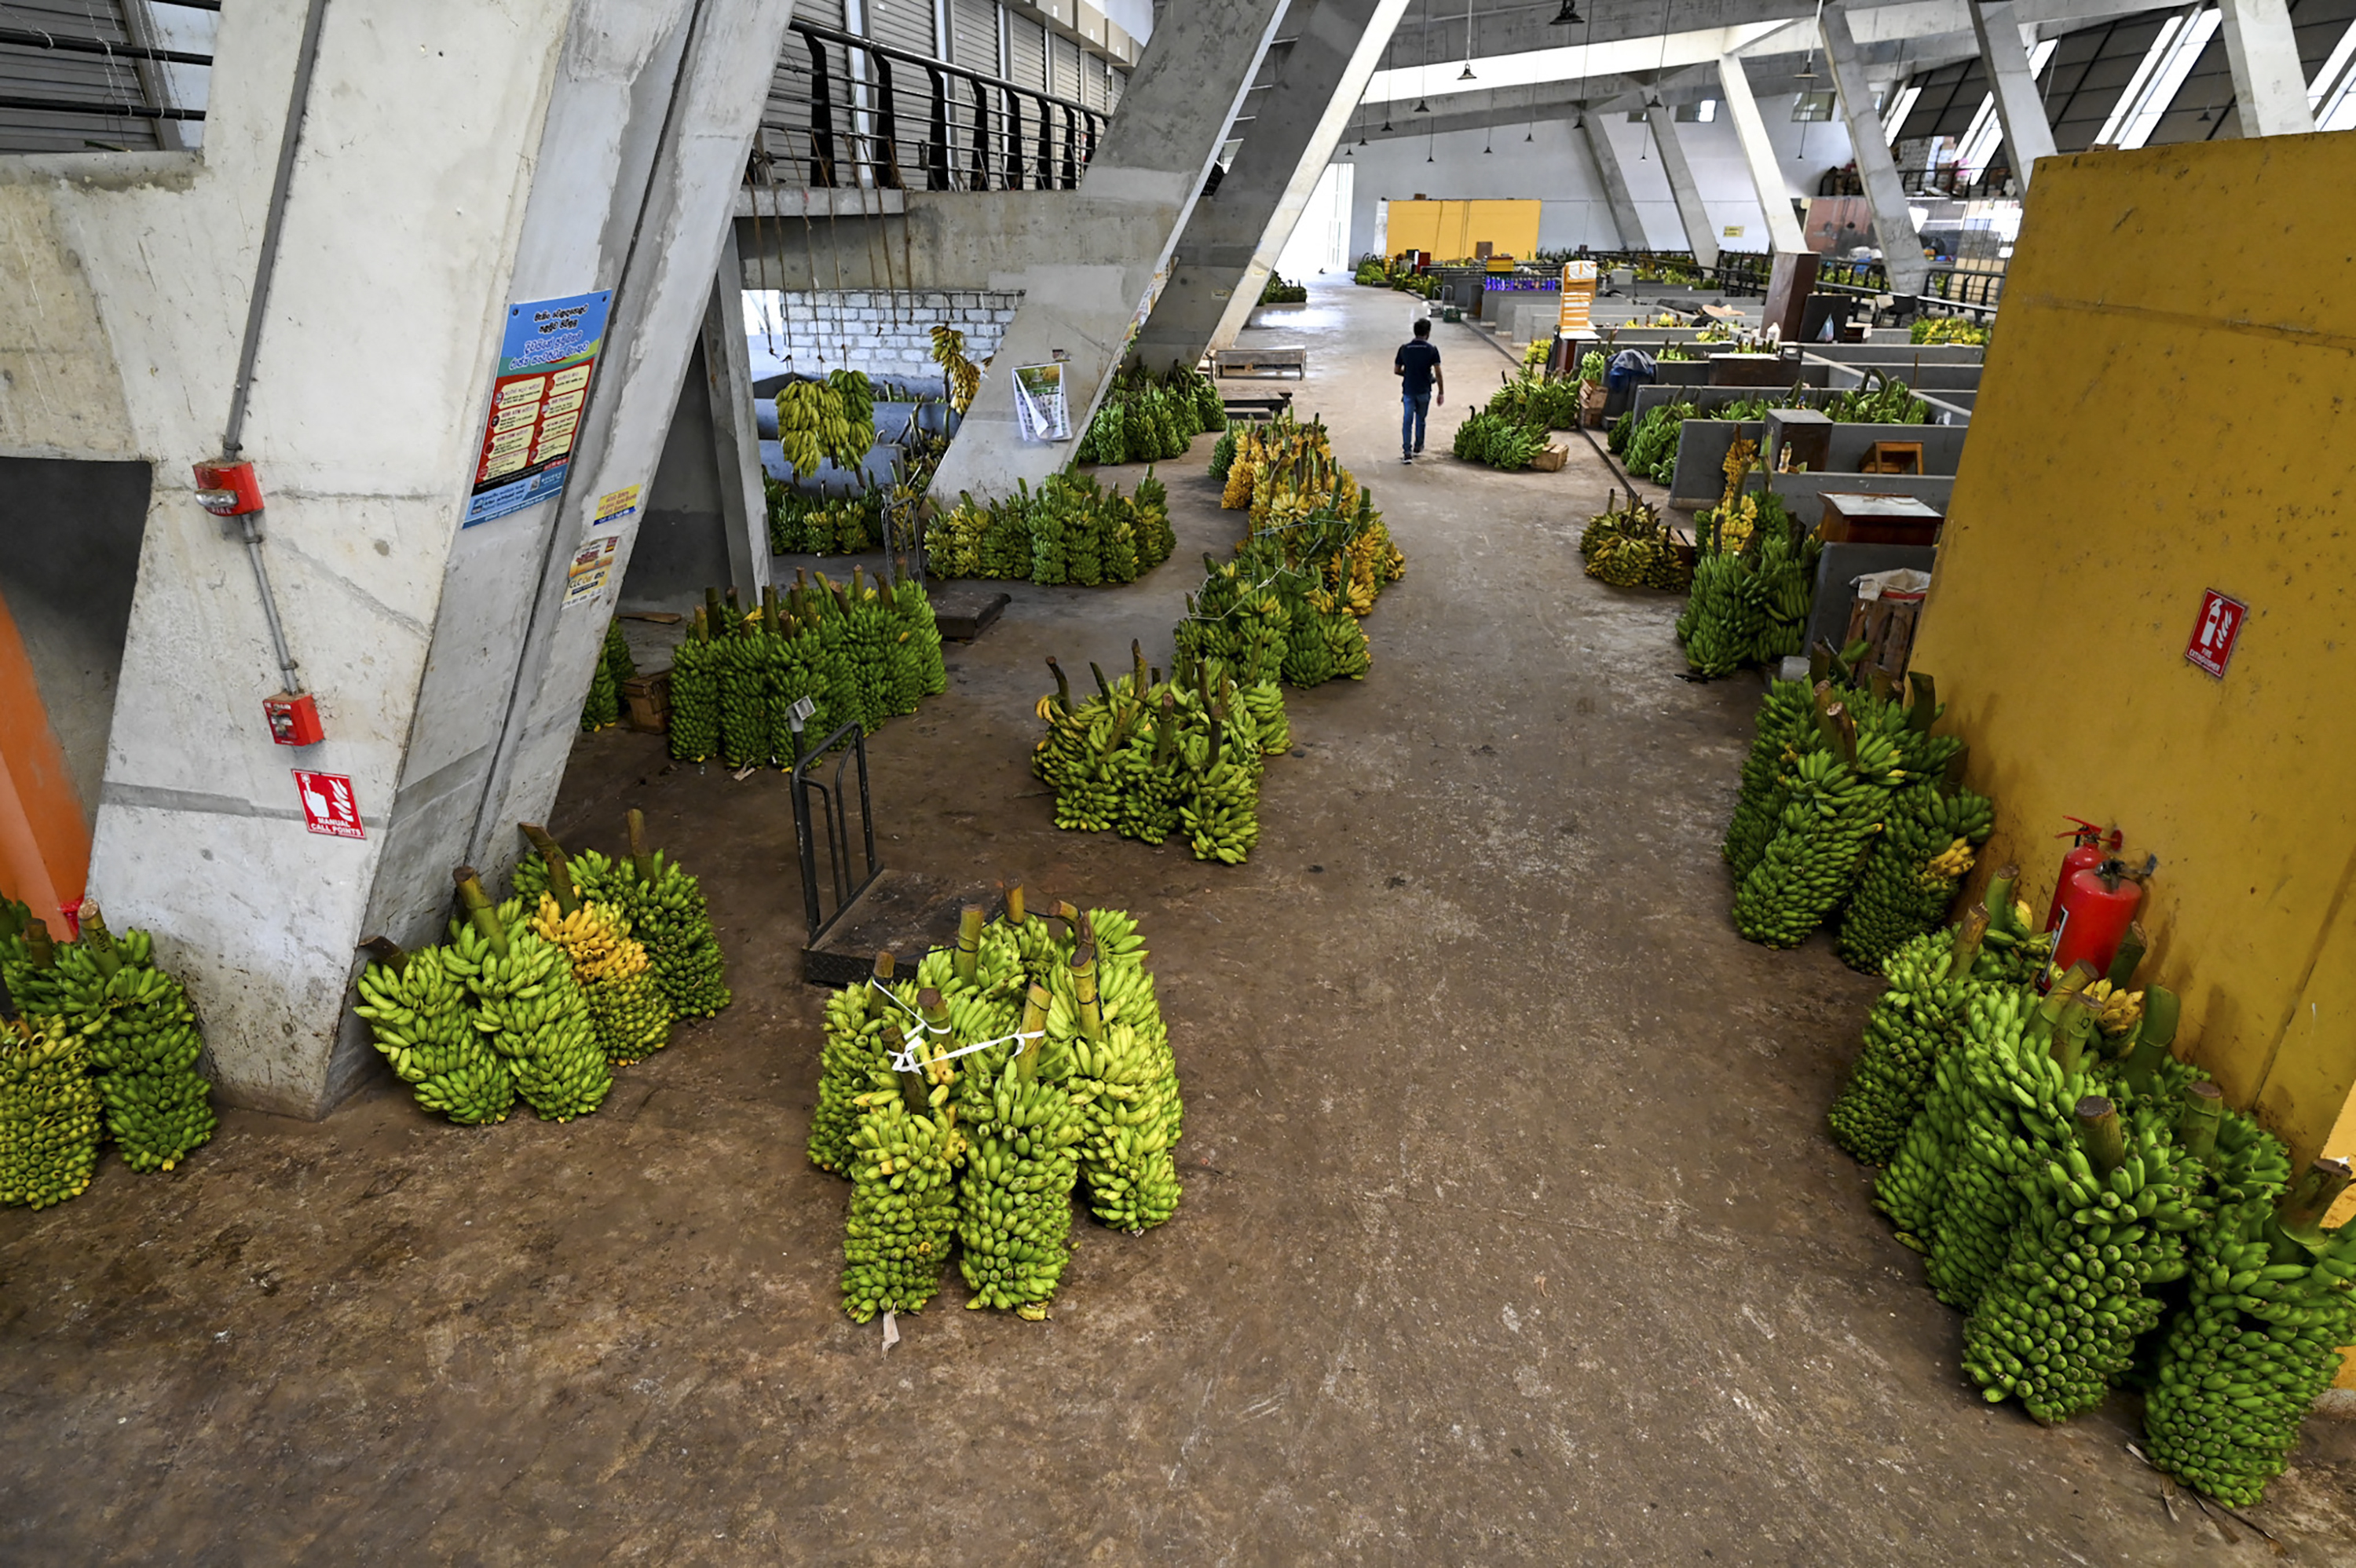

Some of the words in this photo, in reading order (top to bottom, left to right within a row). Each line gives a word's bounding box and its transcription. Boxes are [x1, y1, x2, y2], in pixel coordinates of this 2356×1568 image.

[2201, 648, 2213, 659] FIRE
[2189, 649, 2221, 671] EXTINGUISHER
[317, 817, 351, 828] MANUAL
[311, 824, 331, 832] CALL
[331, 826, 361, 835] POINTS
